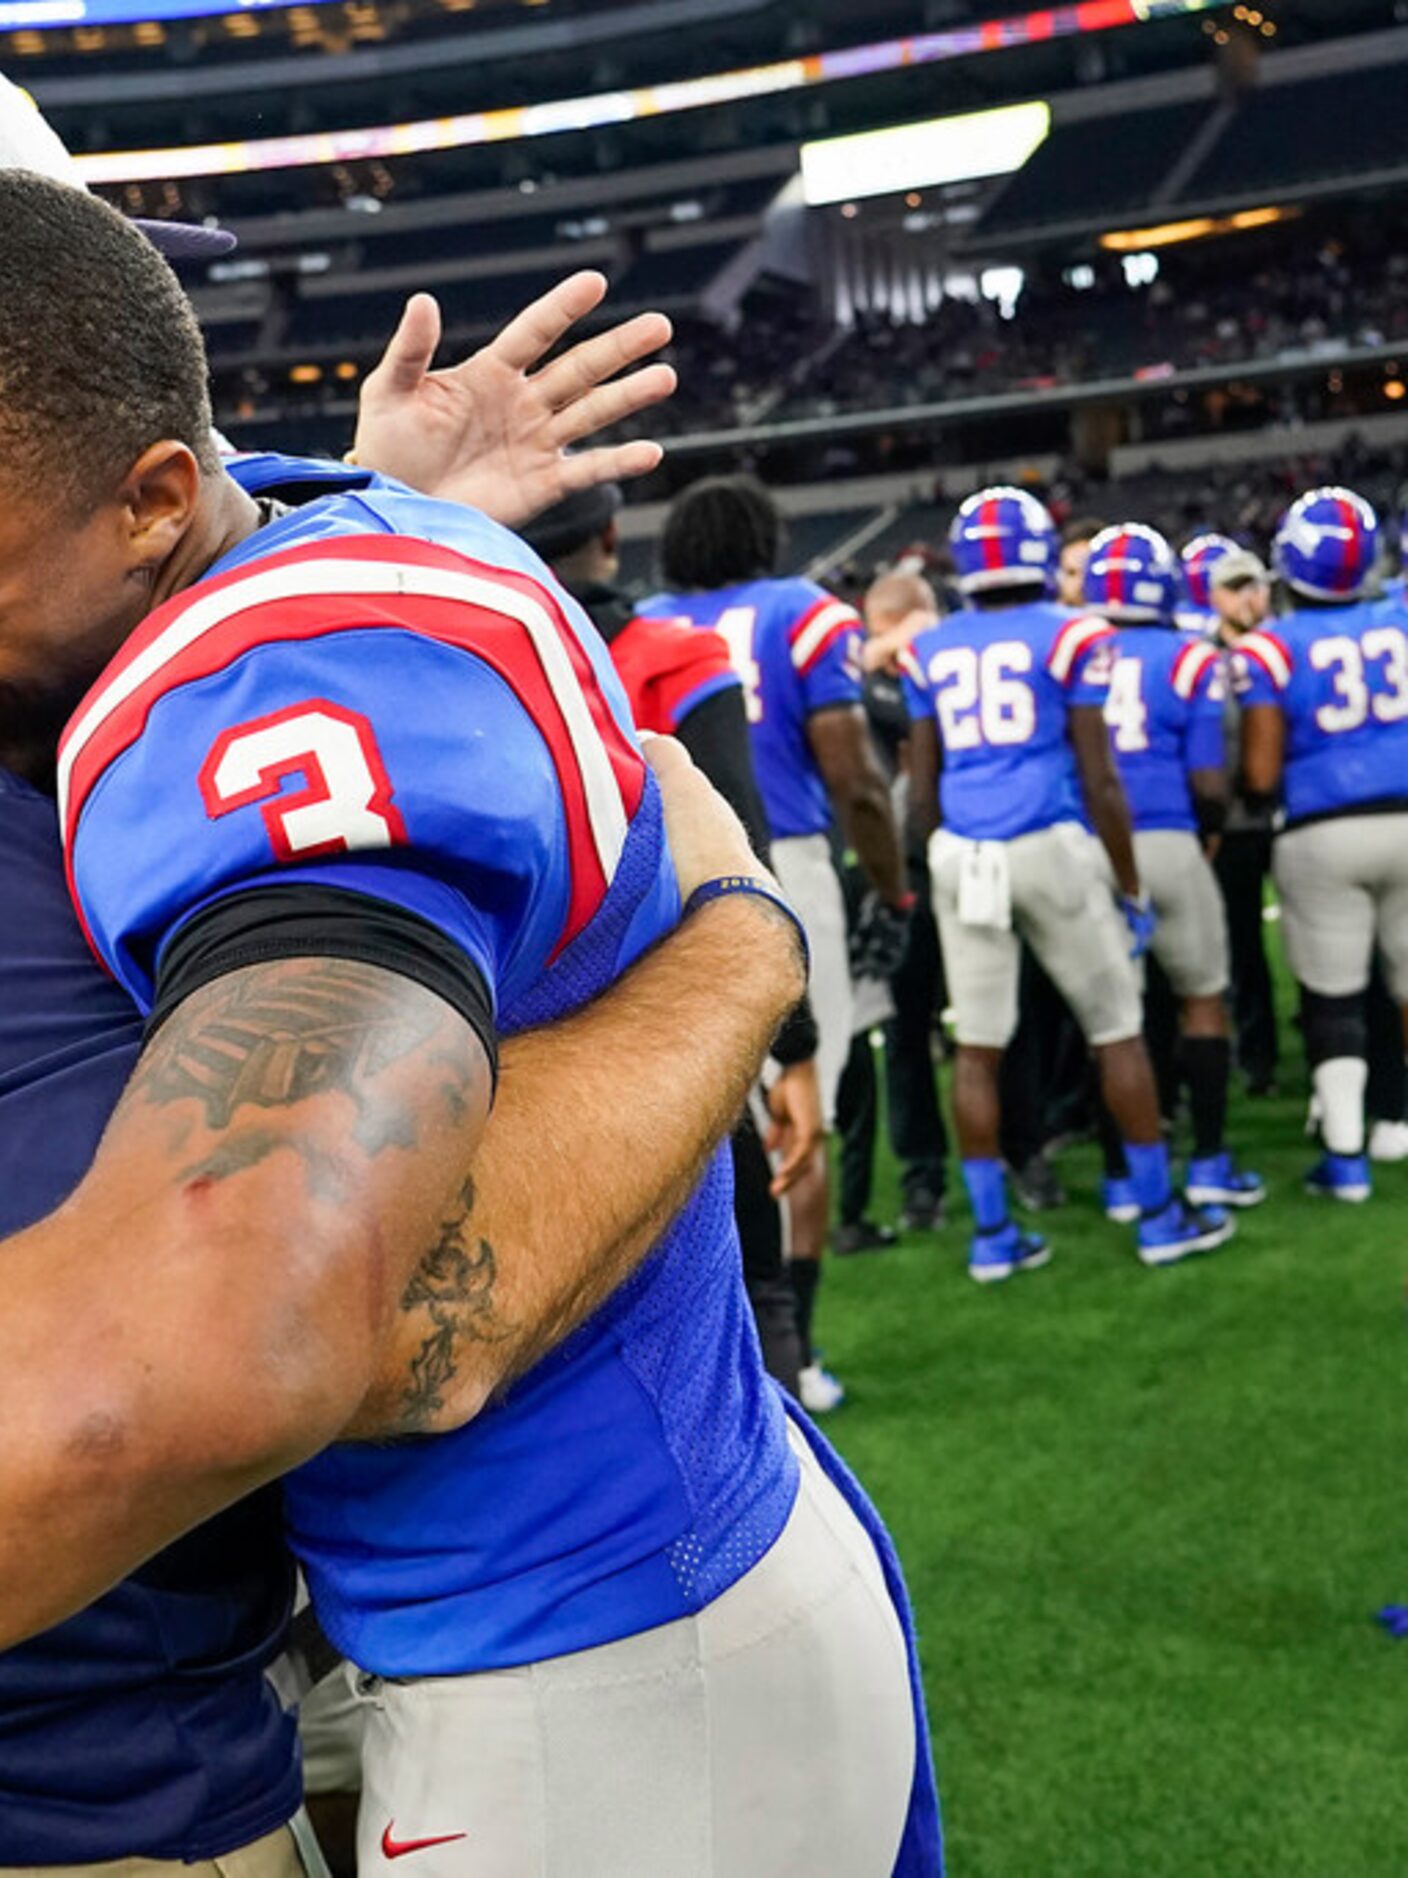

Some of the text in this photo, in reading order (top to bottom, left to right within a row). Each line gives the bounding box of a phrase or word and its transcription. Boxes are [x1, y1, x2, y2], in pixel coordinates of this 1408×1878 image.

[929, 640, 1035, 750] 26
[1309, 626, 1408, 732] 33
[197, 697, 410, 863] 3
